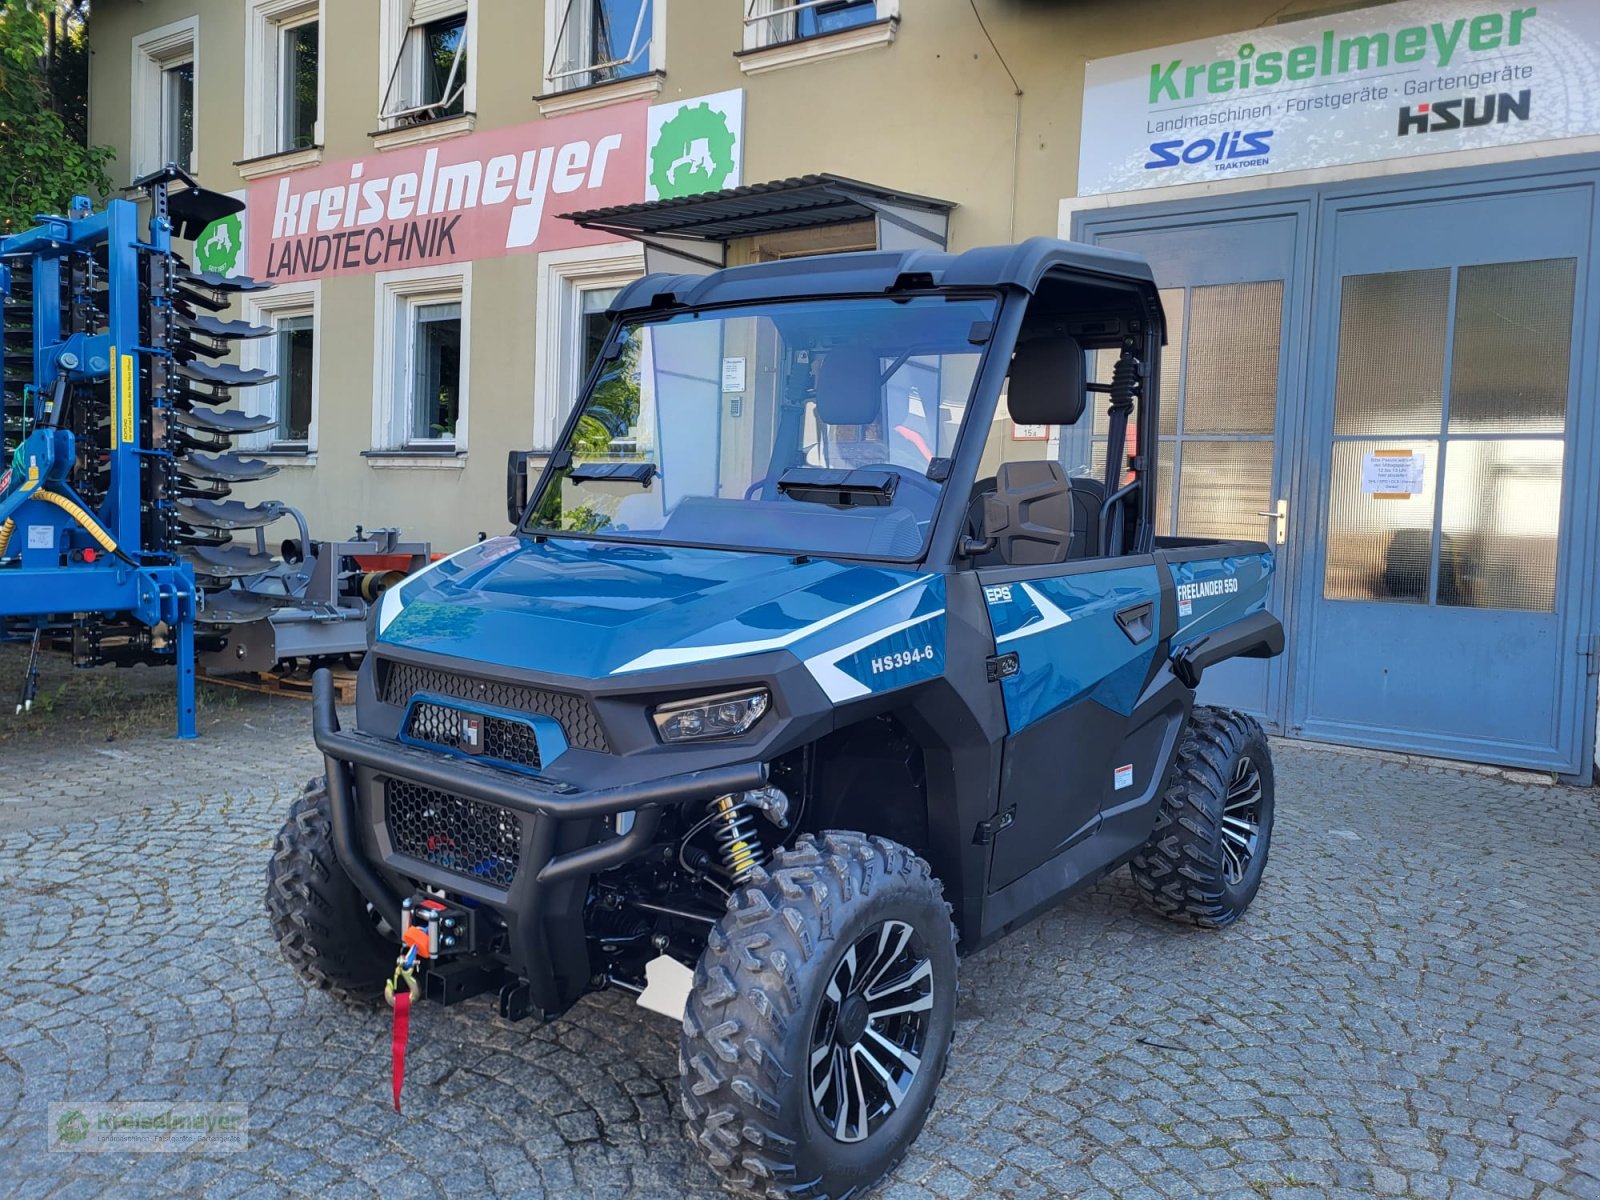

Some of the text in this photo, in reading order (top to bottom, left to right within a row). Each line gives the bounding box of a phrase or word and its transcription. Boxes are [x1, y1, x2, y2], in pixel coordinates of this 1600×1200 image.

[1148, 7, 1537, 104] Kreiselmeyer
[1147, 65, 1533, 134] Landmaschinen Forstgeräte Gartengeräte
[1215, 157, 1269, 171] TRAKTOREN
[272, 133, 622, 249] kreiselmeyer
[266, 214, 462, 279] LANDTECHNIK
[985, 587, 1012, 602] EPS
[1177, 578, 1238, 601] FREELANDER 550
[871, 645, 933, 674] HS394-6
